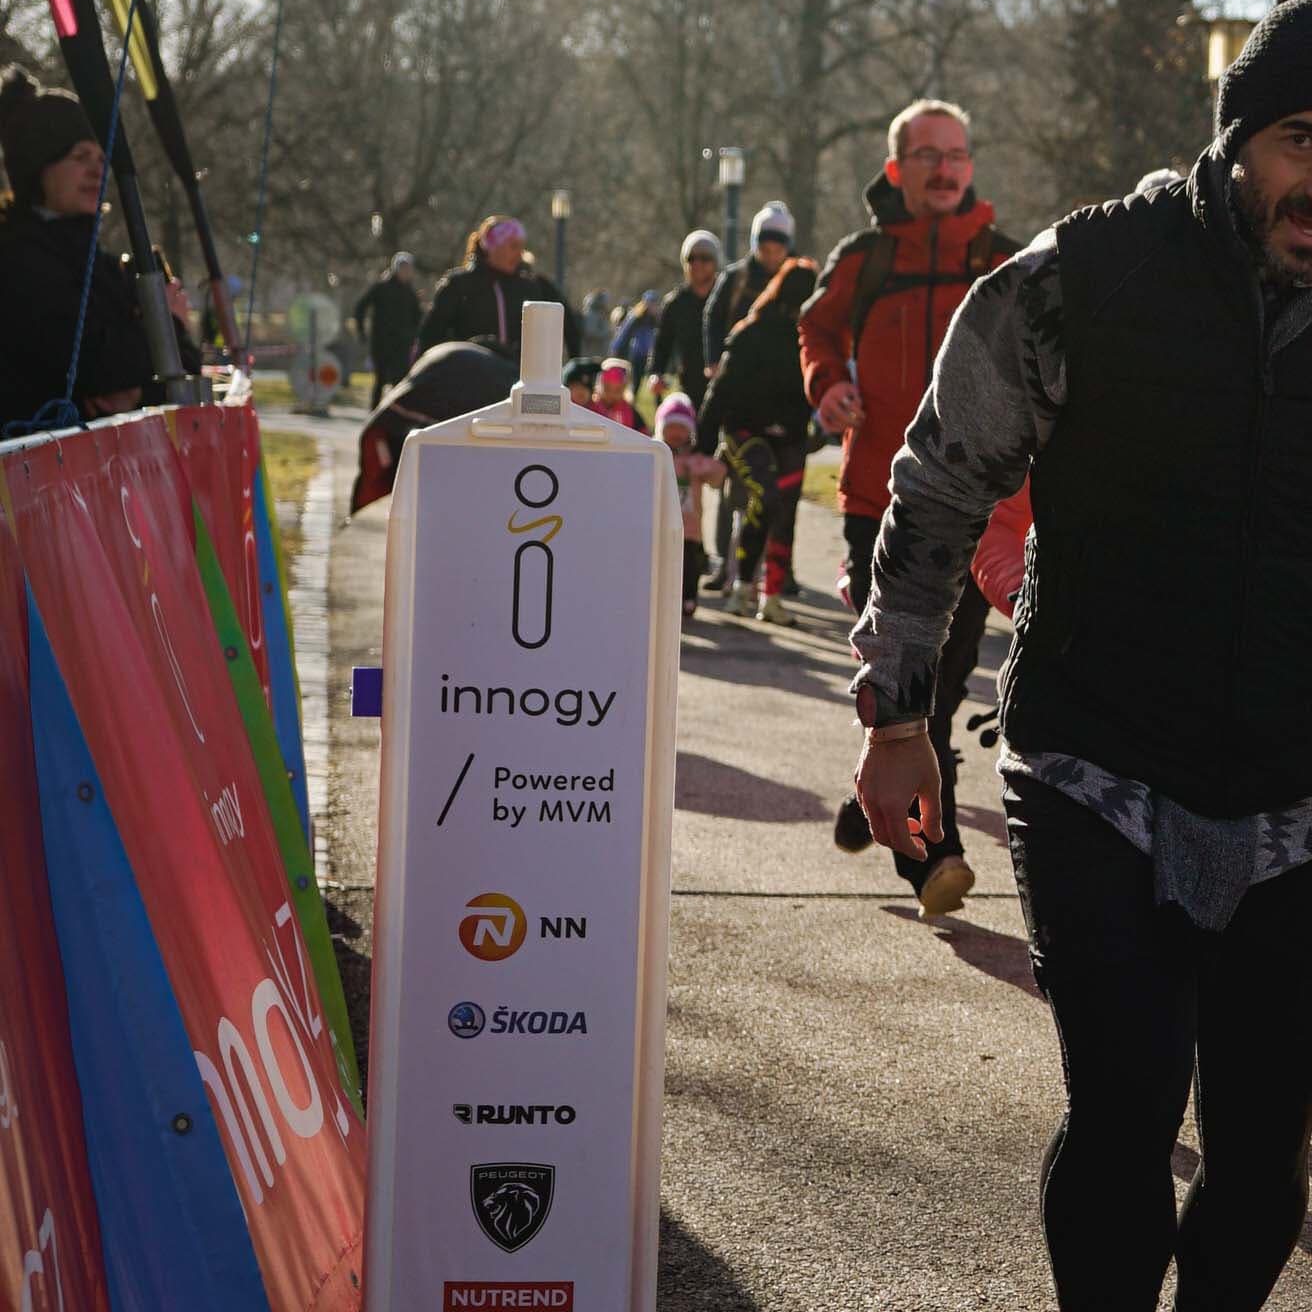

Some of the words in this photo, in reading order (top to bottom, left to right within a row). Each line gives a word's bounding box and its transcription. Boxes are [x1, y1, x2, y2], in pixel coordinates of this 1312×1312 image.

[441, 673, 616, 727] innogy
[494, 766, 614, 792] Powered
[493, 796, 524, 828] by
[540, 800, 612, 823] MVM
[539, 916, 587, 939] NN
[490, 1006, 588, 1035] ŠKODA
[476, 1104, 576, 1126] RUNTO
[478, 1170, 547, 1180] PEUGEOT
[451, 1287, 569, 1308] NUTREND
